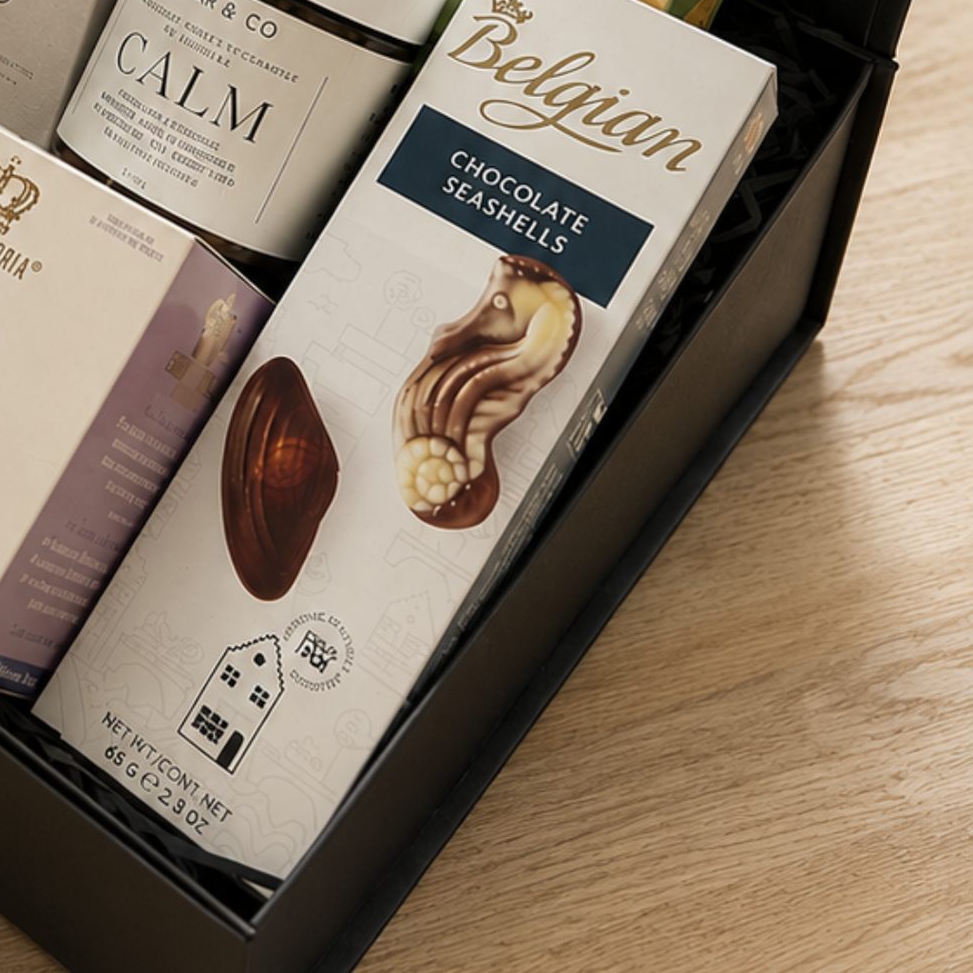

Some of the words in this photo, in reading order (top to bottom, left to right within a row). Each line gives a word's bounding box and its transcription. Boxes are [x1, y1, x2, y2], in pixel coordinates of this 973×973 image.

[221, 2, 237, 19] &
[245, 13, 279, 39] CO
[115, 32, 274, 145] CALM
[447, 13, 703, 172] Belgian
[441, 177, 569, 255] SEASHELLS
[450, 149, 589, 236] CHOCOLATE
[101, 711, 132, 741] NET
[201, 792, 233, 824] NET
[185, 811, 211, 836] OZ
